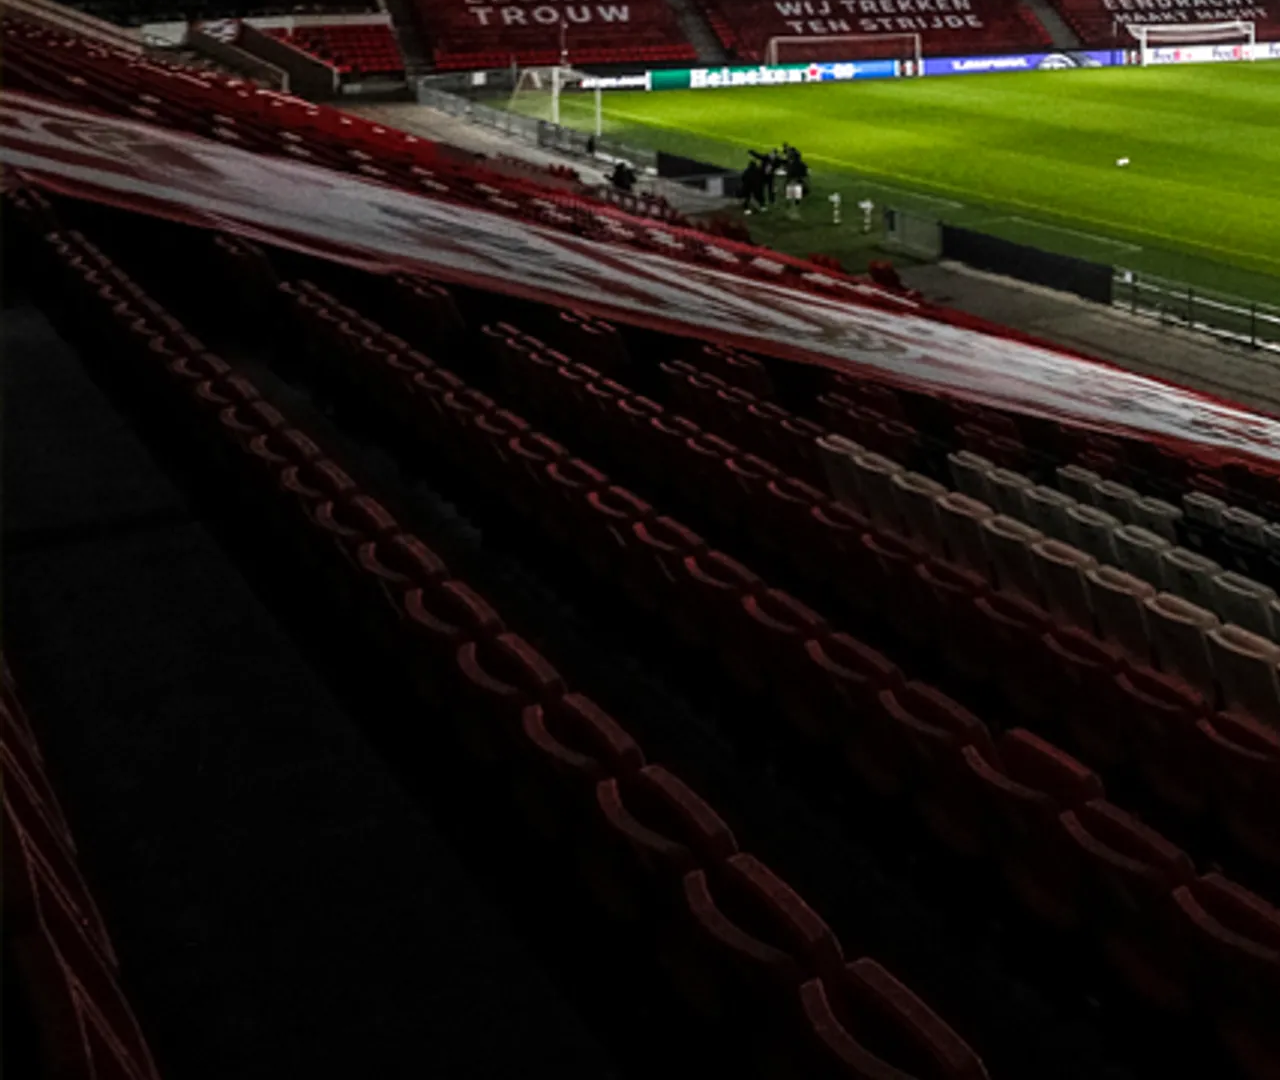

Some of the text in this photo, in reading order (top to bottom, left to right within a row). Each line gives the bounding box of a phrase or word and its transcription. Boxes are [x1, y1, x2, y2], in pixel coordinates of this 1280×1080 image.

[467, 4, 631, 27] TROUW
[773, 0, 831, 17] WIJ
[1112, 10, 1188, 24] MAAKT
[785, 14, 985, 34] TEN STRIJDE
[690, 66, 805, 88] Heineken
